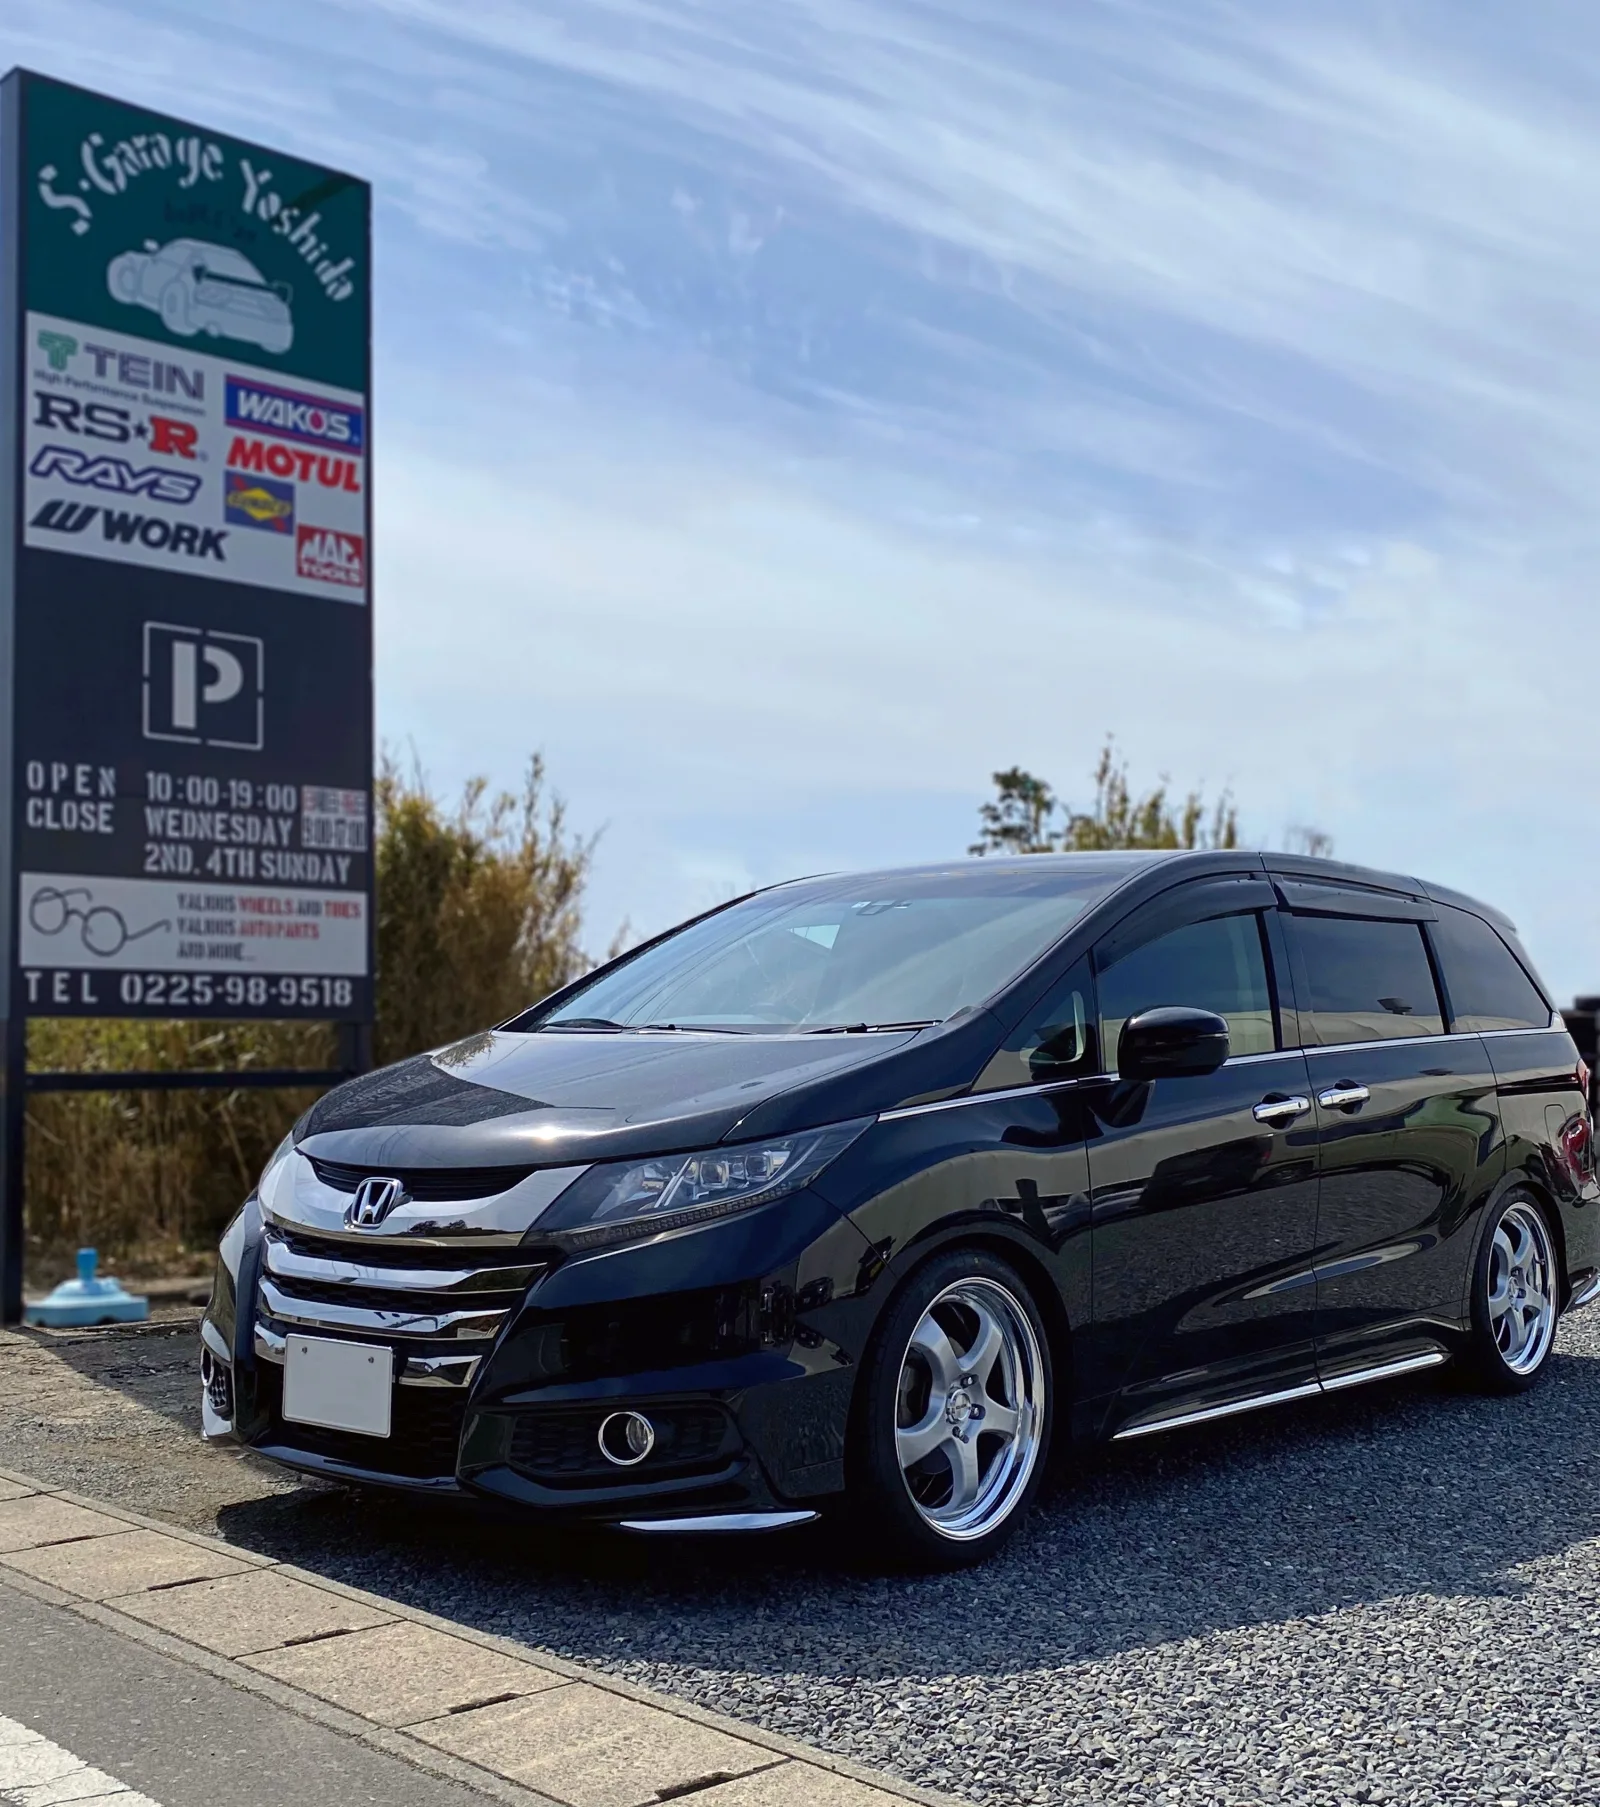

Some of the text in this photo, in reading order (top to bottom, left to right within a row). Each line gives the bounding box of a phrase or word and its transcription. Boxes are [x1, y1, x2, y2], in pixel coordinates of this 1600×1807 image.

[240, 158, 355, 301] Yoshida
[84, 344, 205, 401] TEIN
[29, 445, 202, 504] RAYS
[226, 435, 361, 493] MOTUL
[102, 509, 229, 561] WORK
[172, 640, 243, 730] P
[27, 760, 117, 797] OPEN
[26, 797, 114, 833] CLOSE
[144, 805, 293, 847] WEDNESDAY
[206, 851, 255, 878] 4TH
[260, 854, 351, 885] SUNDAY
[25, 970, 98, 1003] TEL
